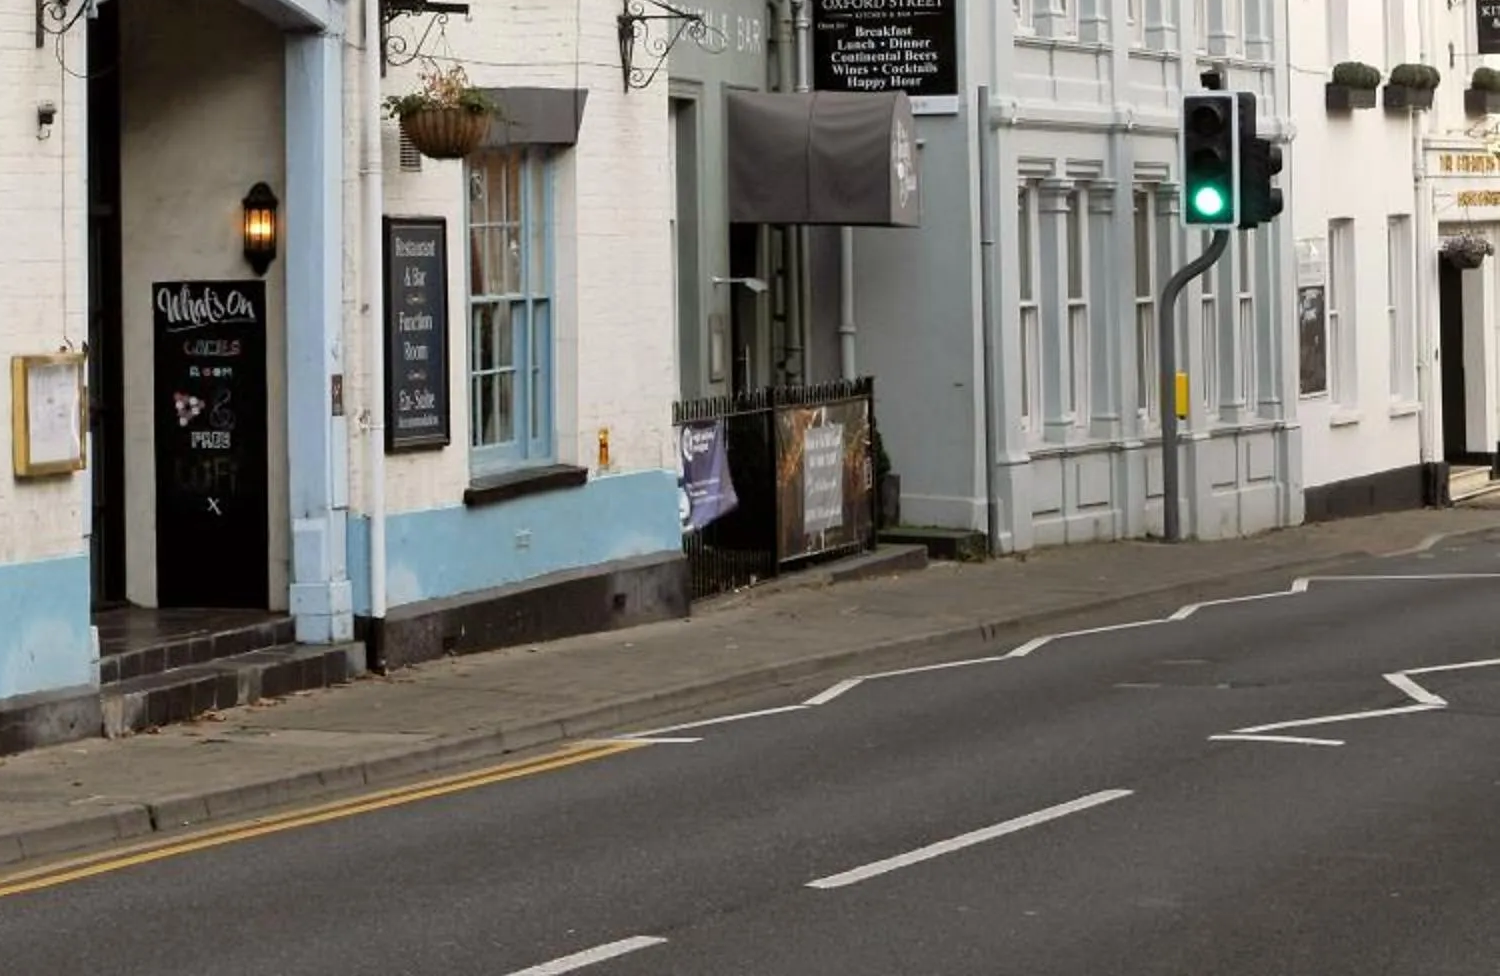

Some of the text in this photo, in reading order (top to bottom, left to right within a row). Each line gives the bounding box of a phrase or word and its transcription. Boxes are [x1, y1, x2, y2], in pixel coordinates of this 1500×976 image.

[737, 15, 762, 53] BAR
[855, 26, 913, 37] Breakfast
[837, 37, 931, 51] Lunch Dinner
[831, 50, 938, 63] Continental Beers
[832, 62, 938, 75] Wines Cocktails
[847, 75, 923, 90] Happy Hour
[396, 237, 435, 257] Restaurant
[412, 267, 426, 286] Bar
[158, 285, 256, 325] What's On
[398, 311, 433, 333] Function
[404, 341, 428, 361] Room
